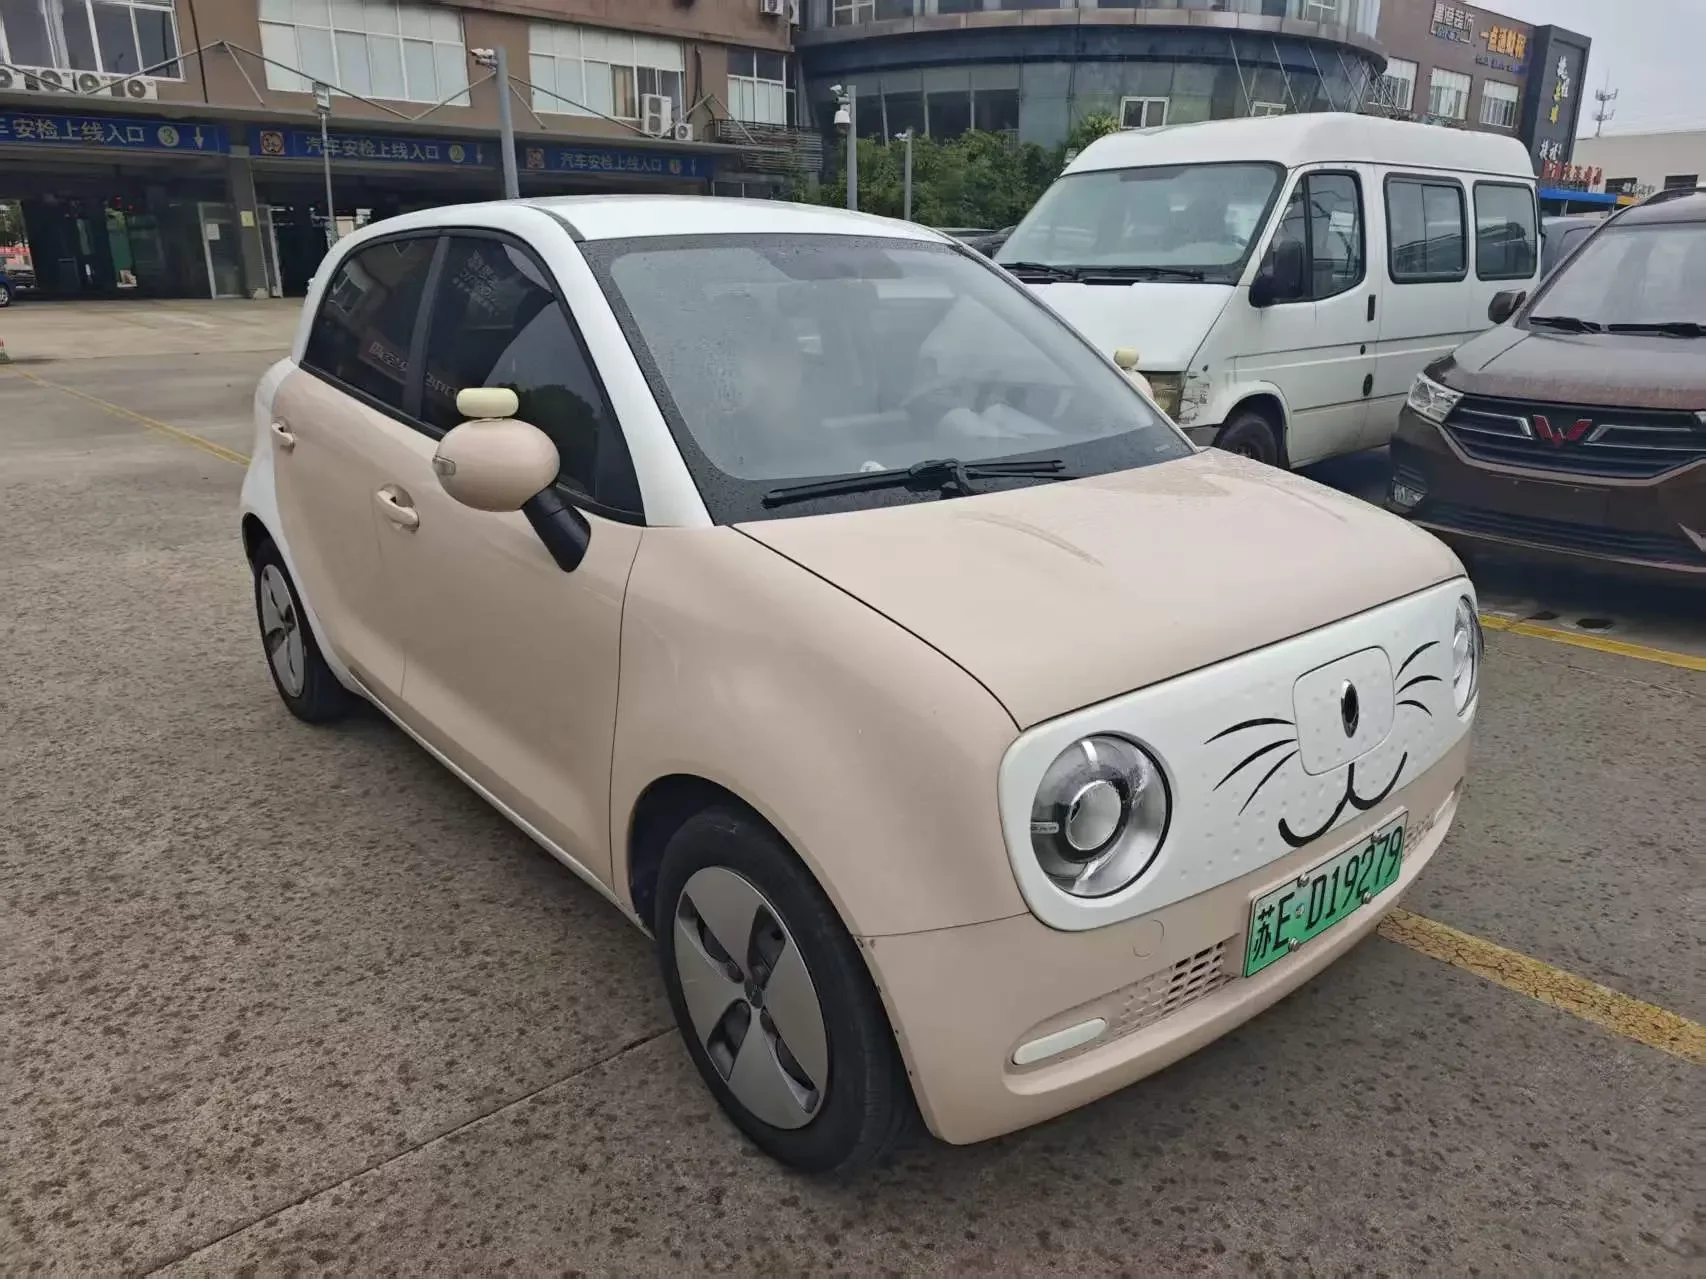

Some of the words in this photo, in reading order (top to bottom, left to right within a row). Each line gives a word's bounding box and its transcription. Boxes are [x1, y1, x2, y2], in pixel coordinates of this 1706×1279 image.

[306, 135, 439, 160] 汽车安检上线入口
[560, 152, 662, 172] 汽车安检上线入口
